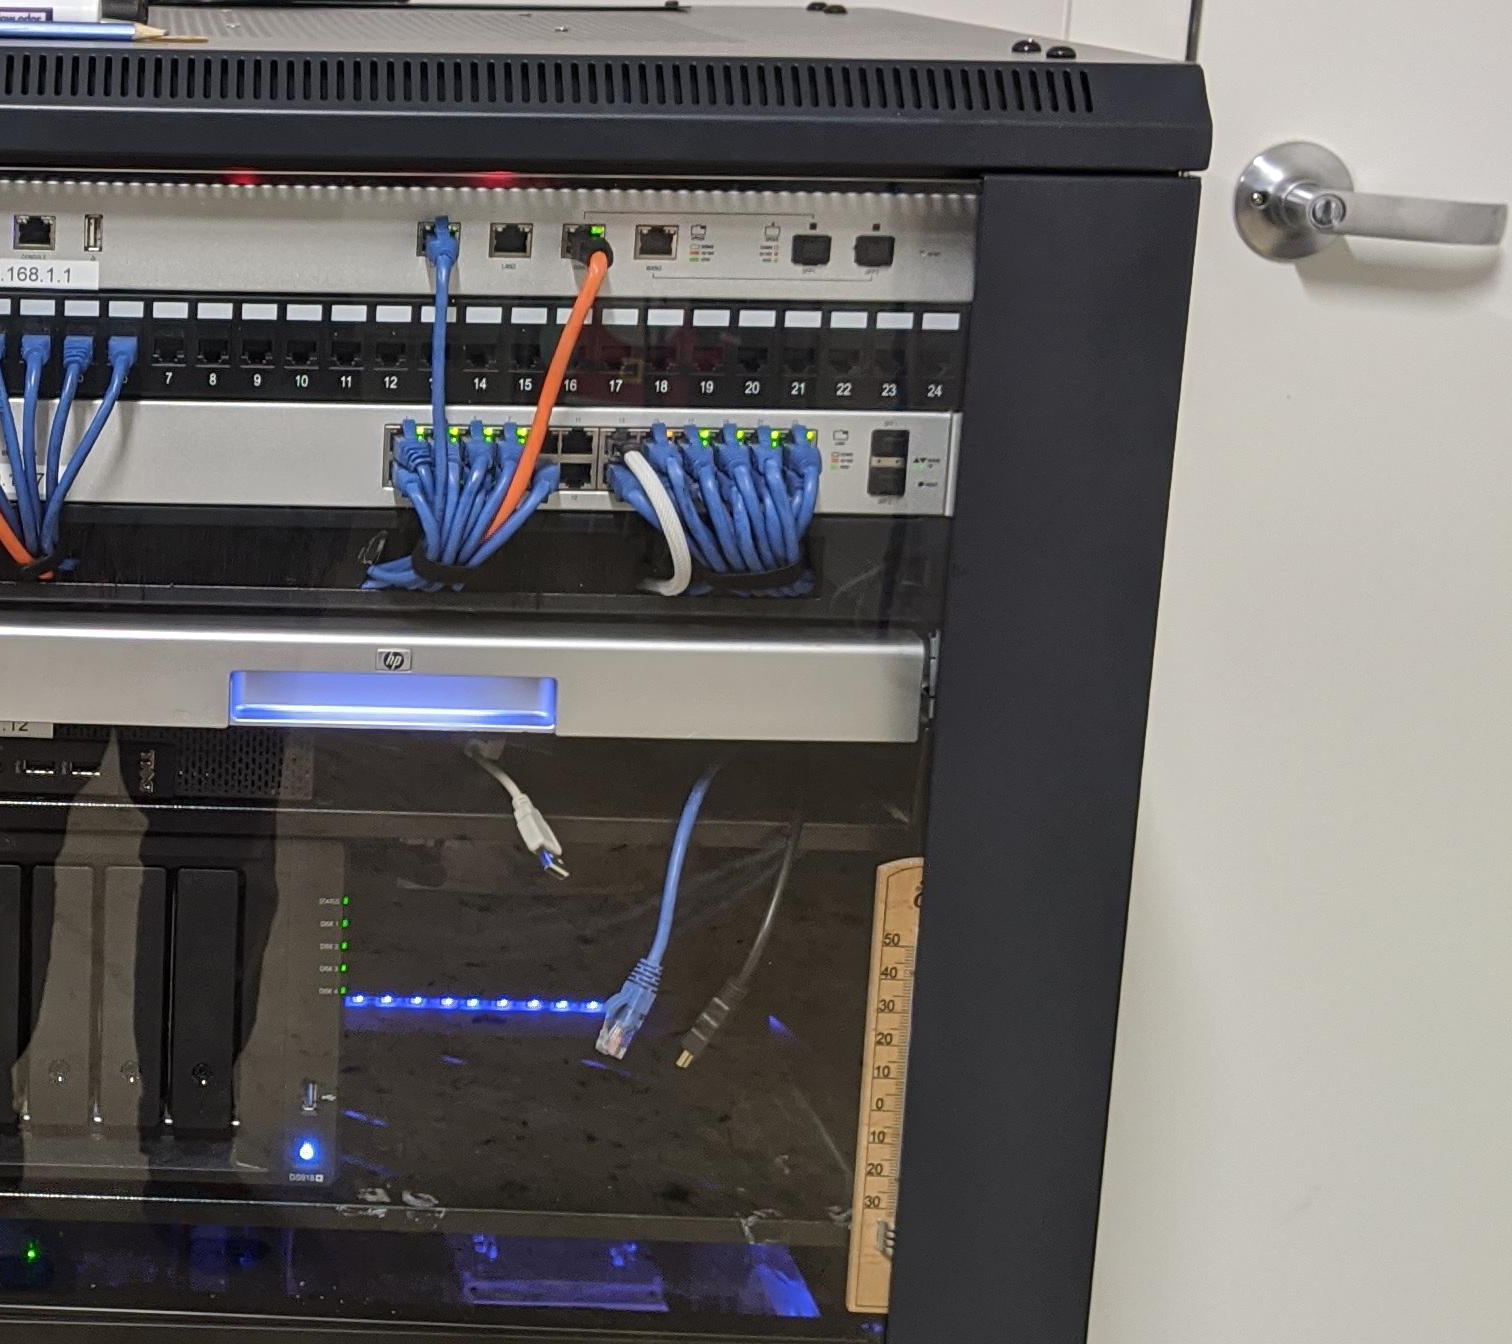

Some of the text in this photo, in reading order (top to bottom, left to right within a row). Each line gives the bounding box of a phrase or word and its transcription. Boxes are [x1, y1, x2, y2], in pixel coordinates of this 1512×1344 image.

[165, 372, 943, 398] 7 8 9 10 11 12 14 15 16 17 18 19 20 21 22 23 24
[384, 651, 404, 671] hp
[864, 932, 901, 1208] 50 40 30 20 10 0 10 20 30
